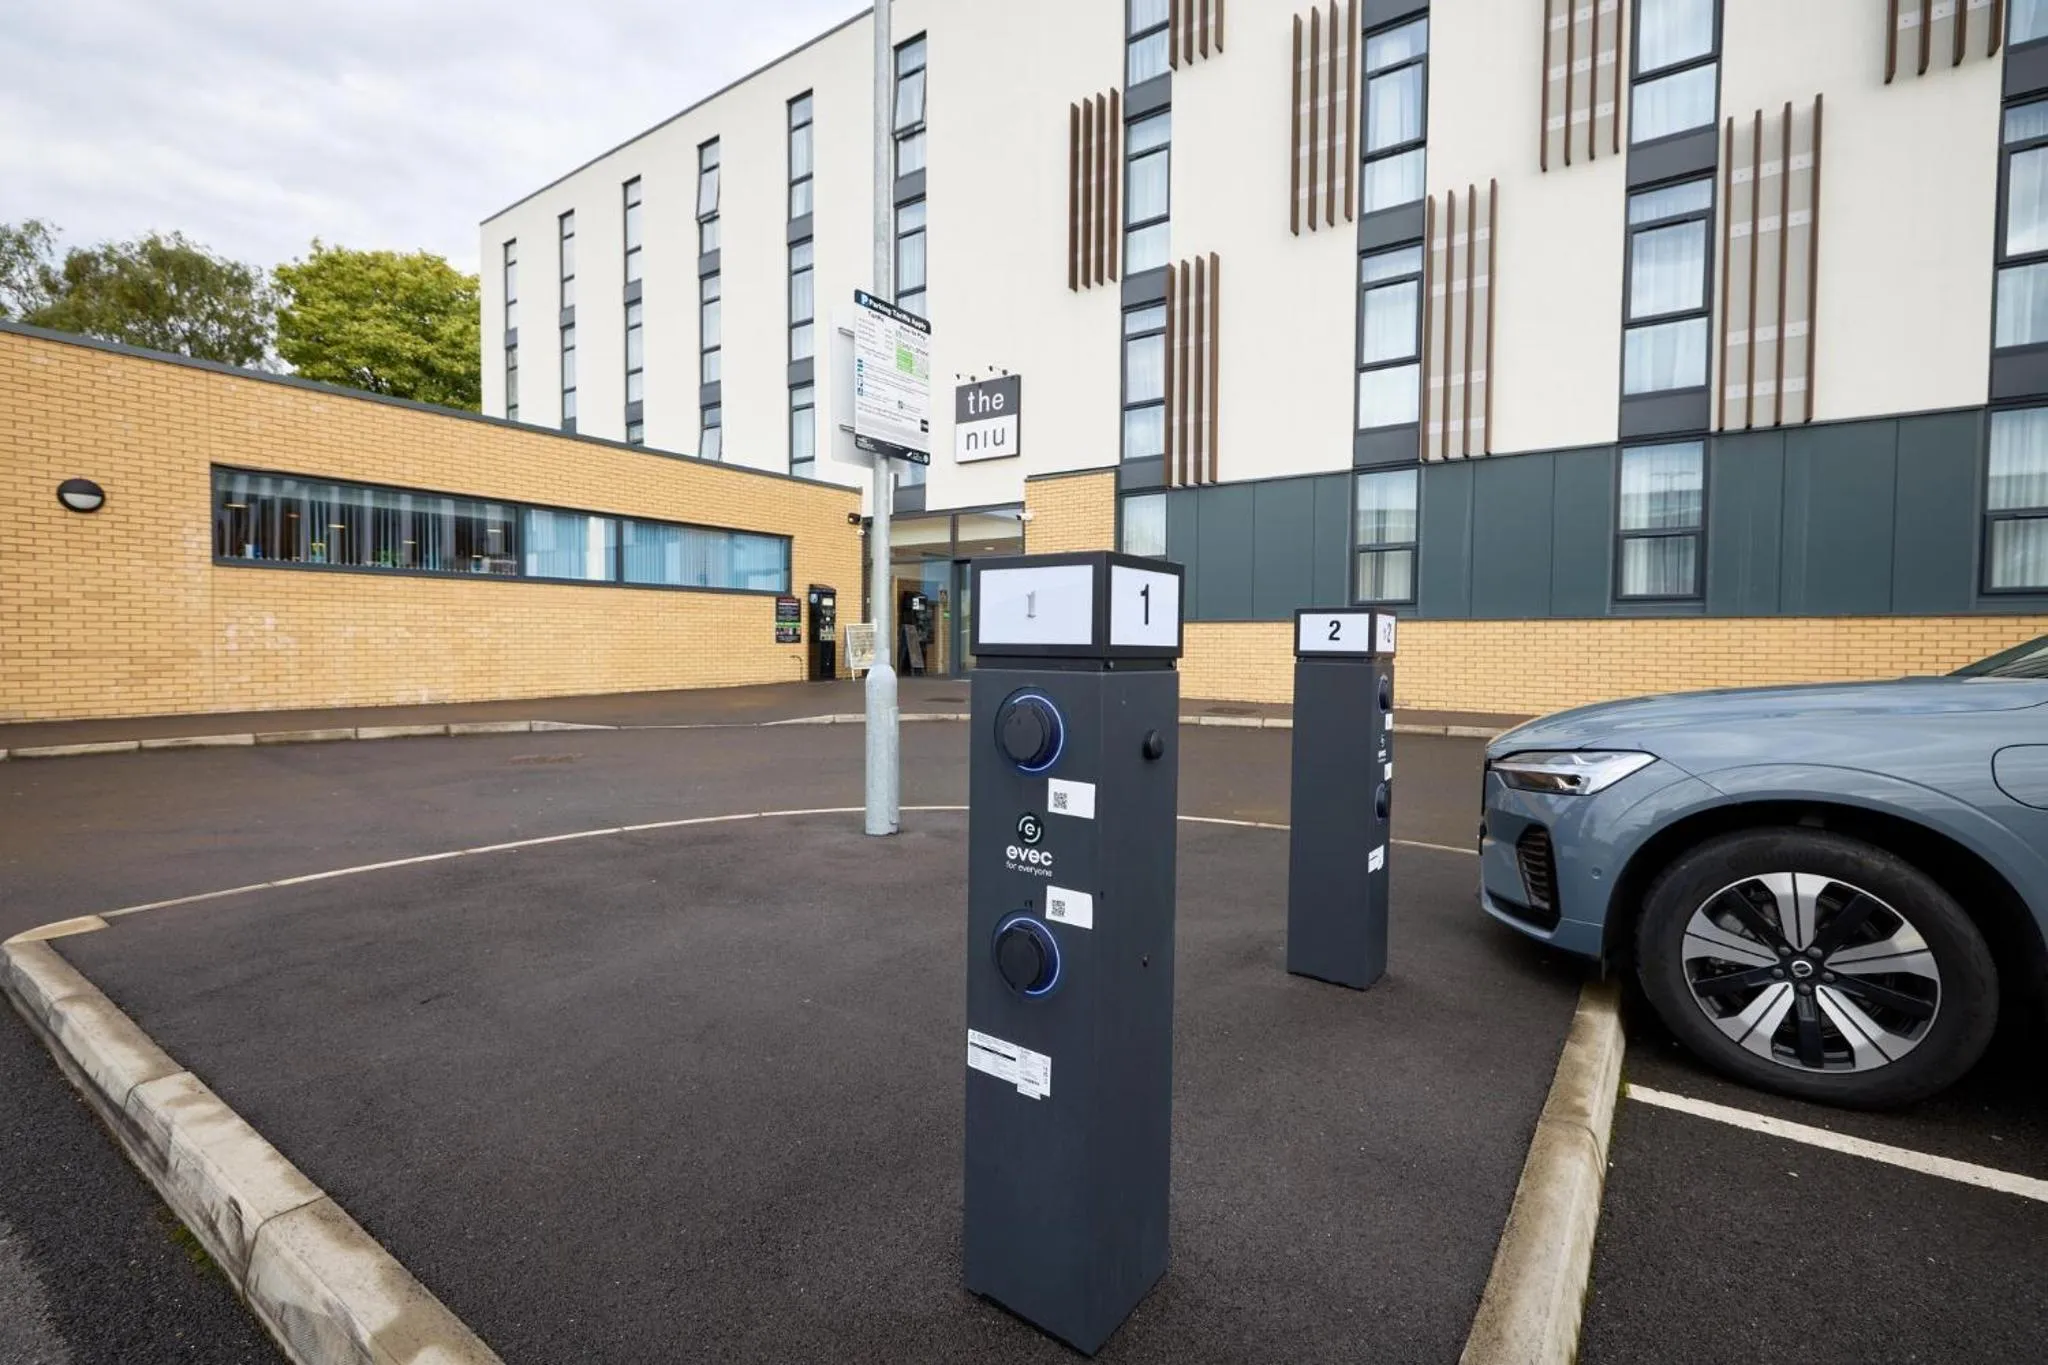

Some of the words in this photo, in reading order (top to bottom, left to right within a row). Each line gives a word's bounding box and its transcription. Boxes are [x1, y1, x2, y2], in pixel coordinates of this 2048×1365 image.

[869, 298, 892, 317] Parking
[893, 309, 911, 324] Tariffs
[912, 318, 927, 331] Apply
[968, 389, 1005, 415] the
[966, 427, 1005, 450] niu
[1026, 590, 1037, 618] 1
[1140, 583, 1149, 626] 1
[1328, 620, 1341, 641] 2
[1006, 845, 1053, 866] evec
[1006, 859, 1017, 870] for
[1018, 864, 1052, 877] everyone
